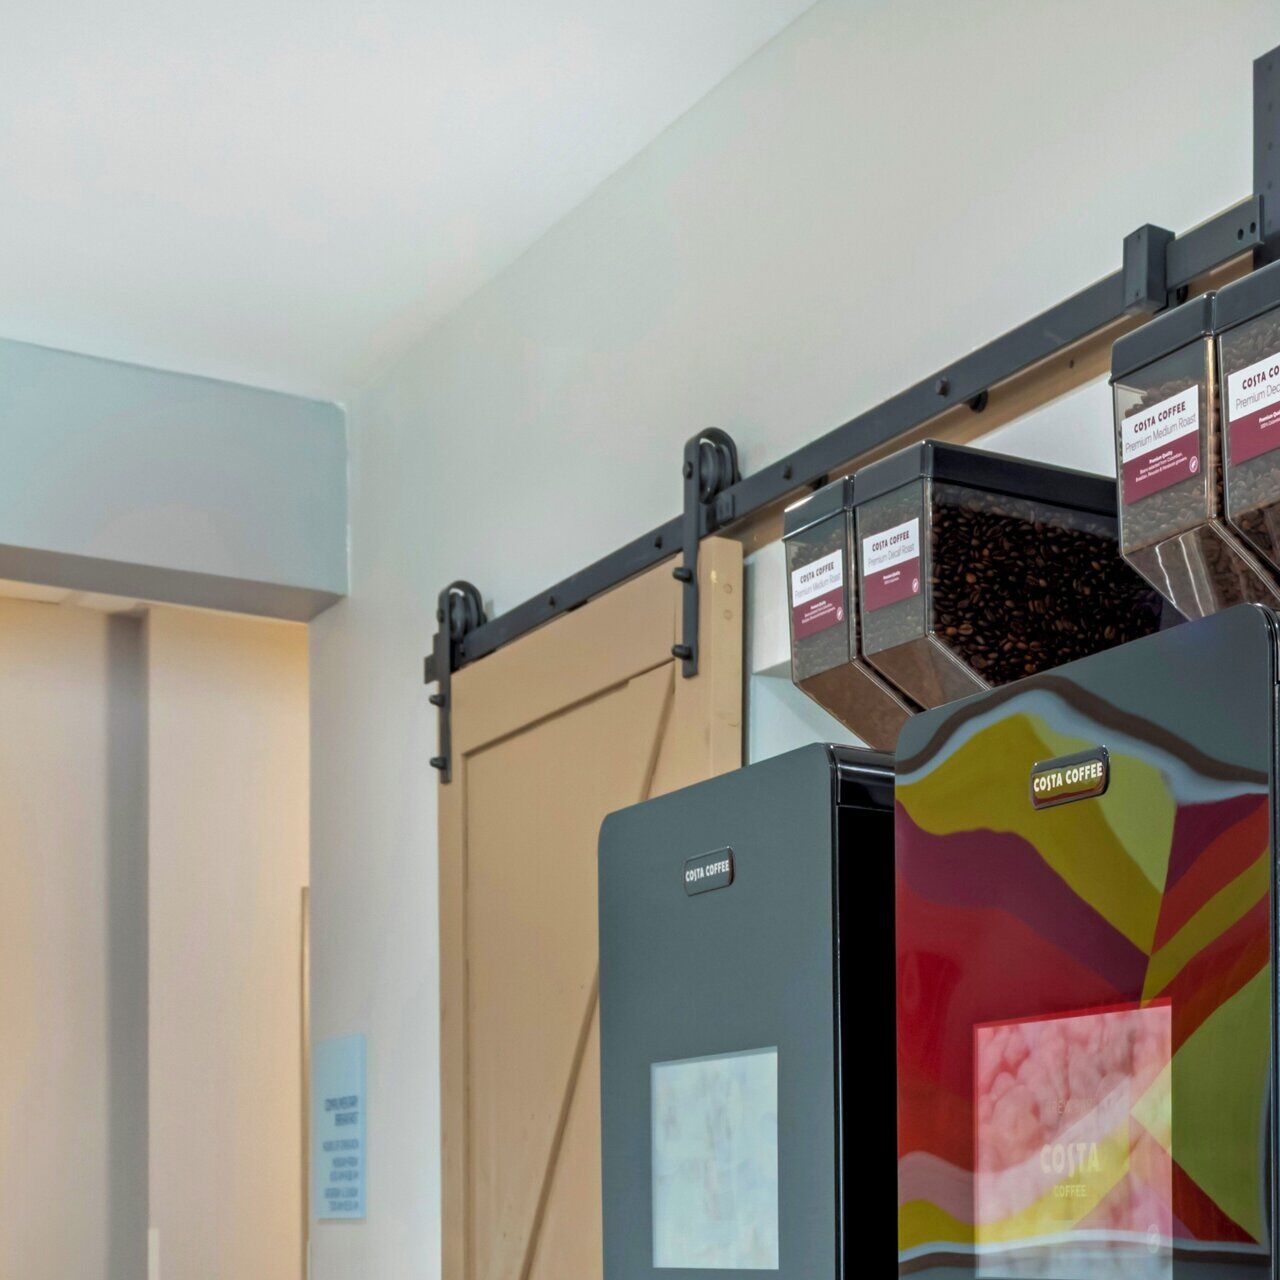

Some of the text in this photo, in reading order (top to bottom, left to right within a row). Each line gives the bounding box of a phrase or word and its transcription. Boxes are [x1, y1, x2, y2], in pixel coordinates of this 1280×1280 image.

[1242, 371, 1266, 390] COSTA
[1235, 390, 1266, 410] Premium
[1133, 401, 1186, 434] COSTA COFFEE
[1125, 413, 1197, 453] Premium Medium Roast
[872, 530, 910, 552] COSTA COFFEE
[800, 561, 834, 584] COSTA COFFEE
[1033, 761, 1103, 792] COSTA COFFEE
[685, 859, 730, 882] COSTA COFFEE
[1040, 1142, 1101, 1178] COSTA
[1054, 1184, 1087, 1198] COFFEE
